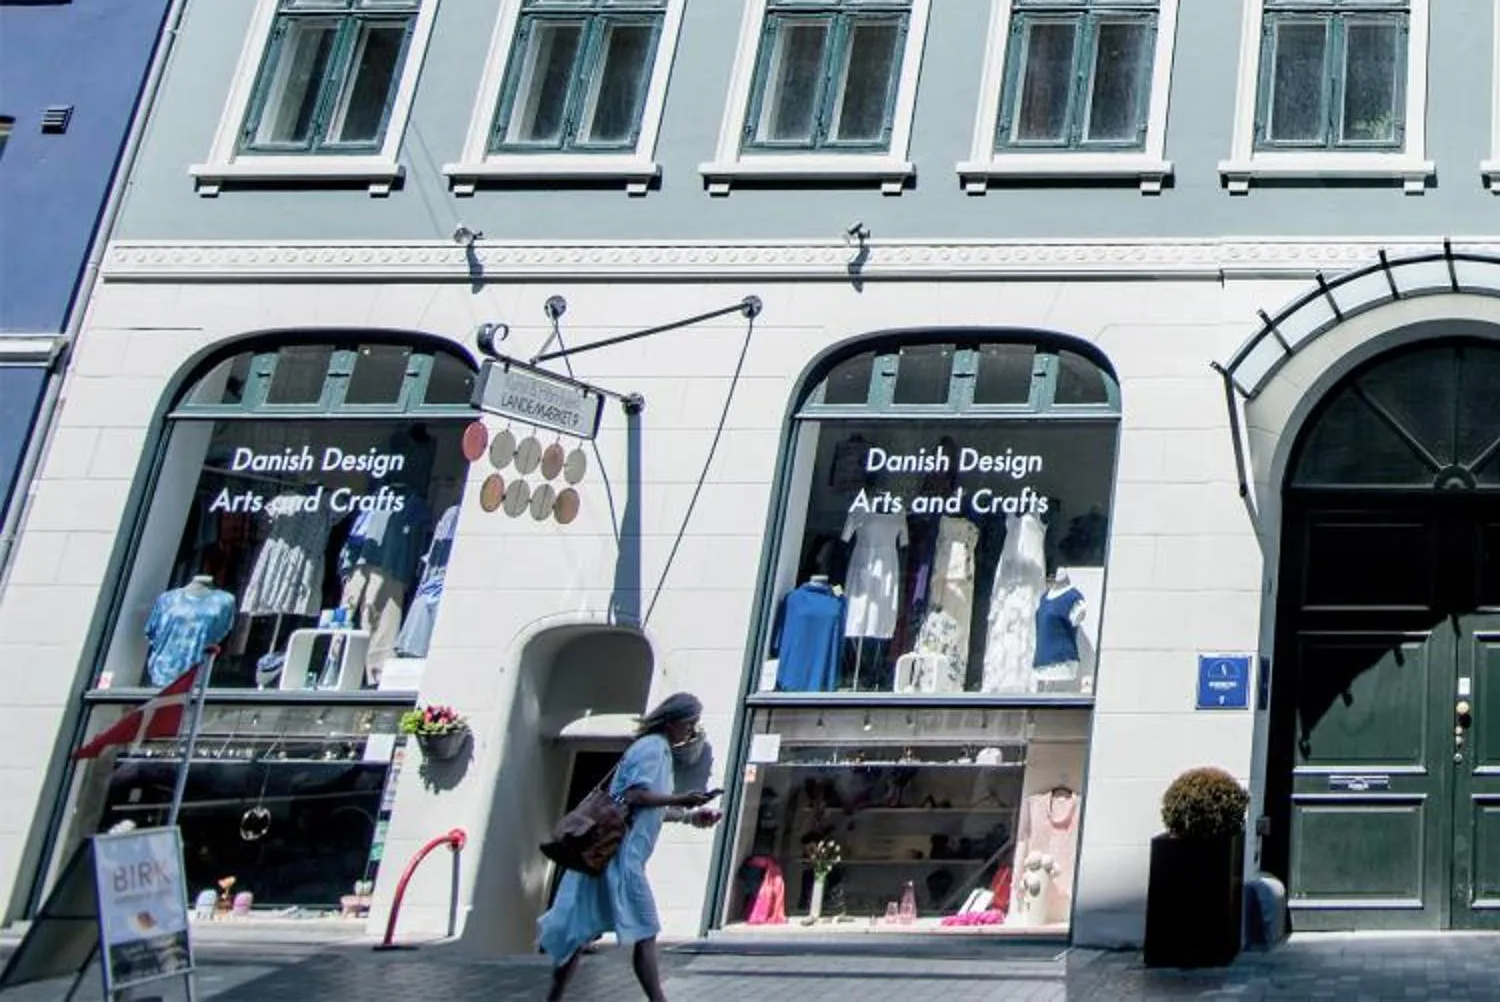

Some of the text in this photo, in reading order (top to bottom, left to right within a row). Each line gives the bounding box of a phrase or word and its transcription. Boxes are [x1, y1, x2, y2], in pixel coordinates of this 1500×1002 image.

[231, 446, 405, 478] Danish Design
[866, 446, 1043, 479] Danish Design
[209, 485, 405, 513] Arts and Crafts
[848, 485, 1049, 513] Arts and Crafts
